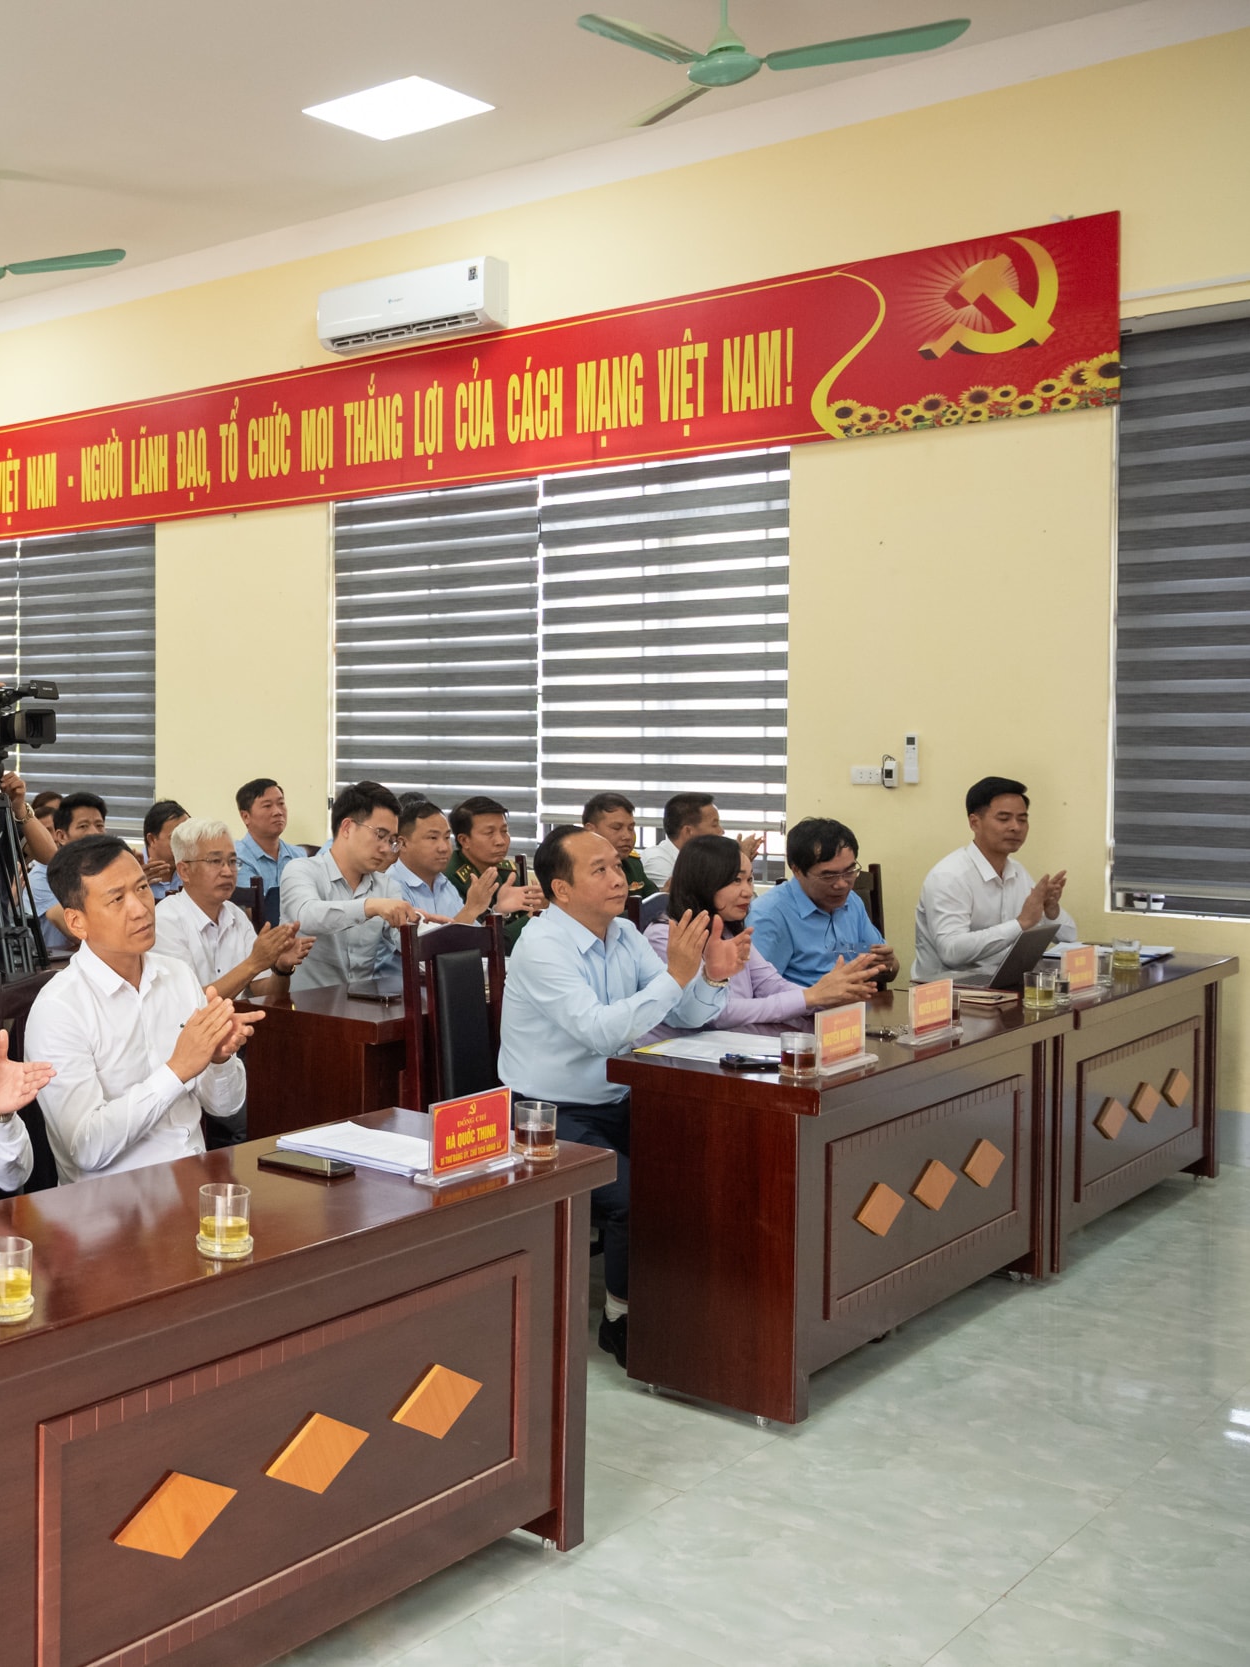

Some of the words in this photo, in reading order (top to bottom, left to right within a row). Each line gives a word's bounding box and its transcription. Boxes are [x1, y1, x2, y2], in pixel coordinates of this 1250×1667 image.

[26, 452, 57, 510] NAM
[81, 428, 123, 503] NGƯỜI
[131, 426, 168, 496] LÃNH
[176, 427, 211, 501] ĐẠO,
[219, 396, 239, 483] TỔ
[248, 401, 291, 480] CHỨC
[301, 406, 334, 484] MỌI
[344, 372, 403, 466] THẮNG
[414, 380, 443, 470] LỢI
[455, 357, 495, 451] CỦA
[507, 356, 563, 444] CÁCH
[576, 352, 644, 447] MẠNG
[657, 328, 708, 437] VIỆT
[722, 327, 793, 414] NAM!
[446, 1132, 456, 1150] HÀ
[457, 1125, 476, 1148] QUỐC
[477, 1123, 497, 1143] THỊNH
